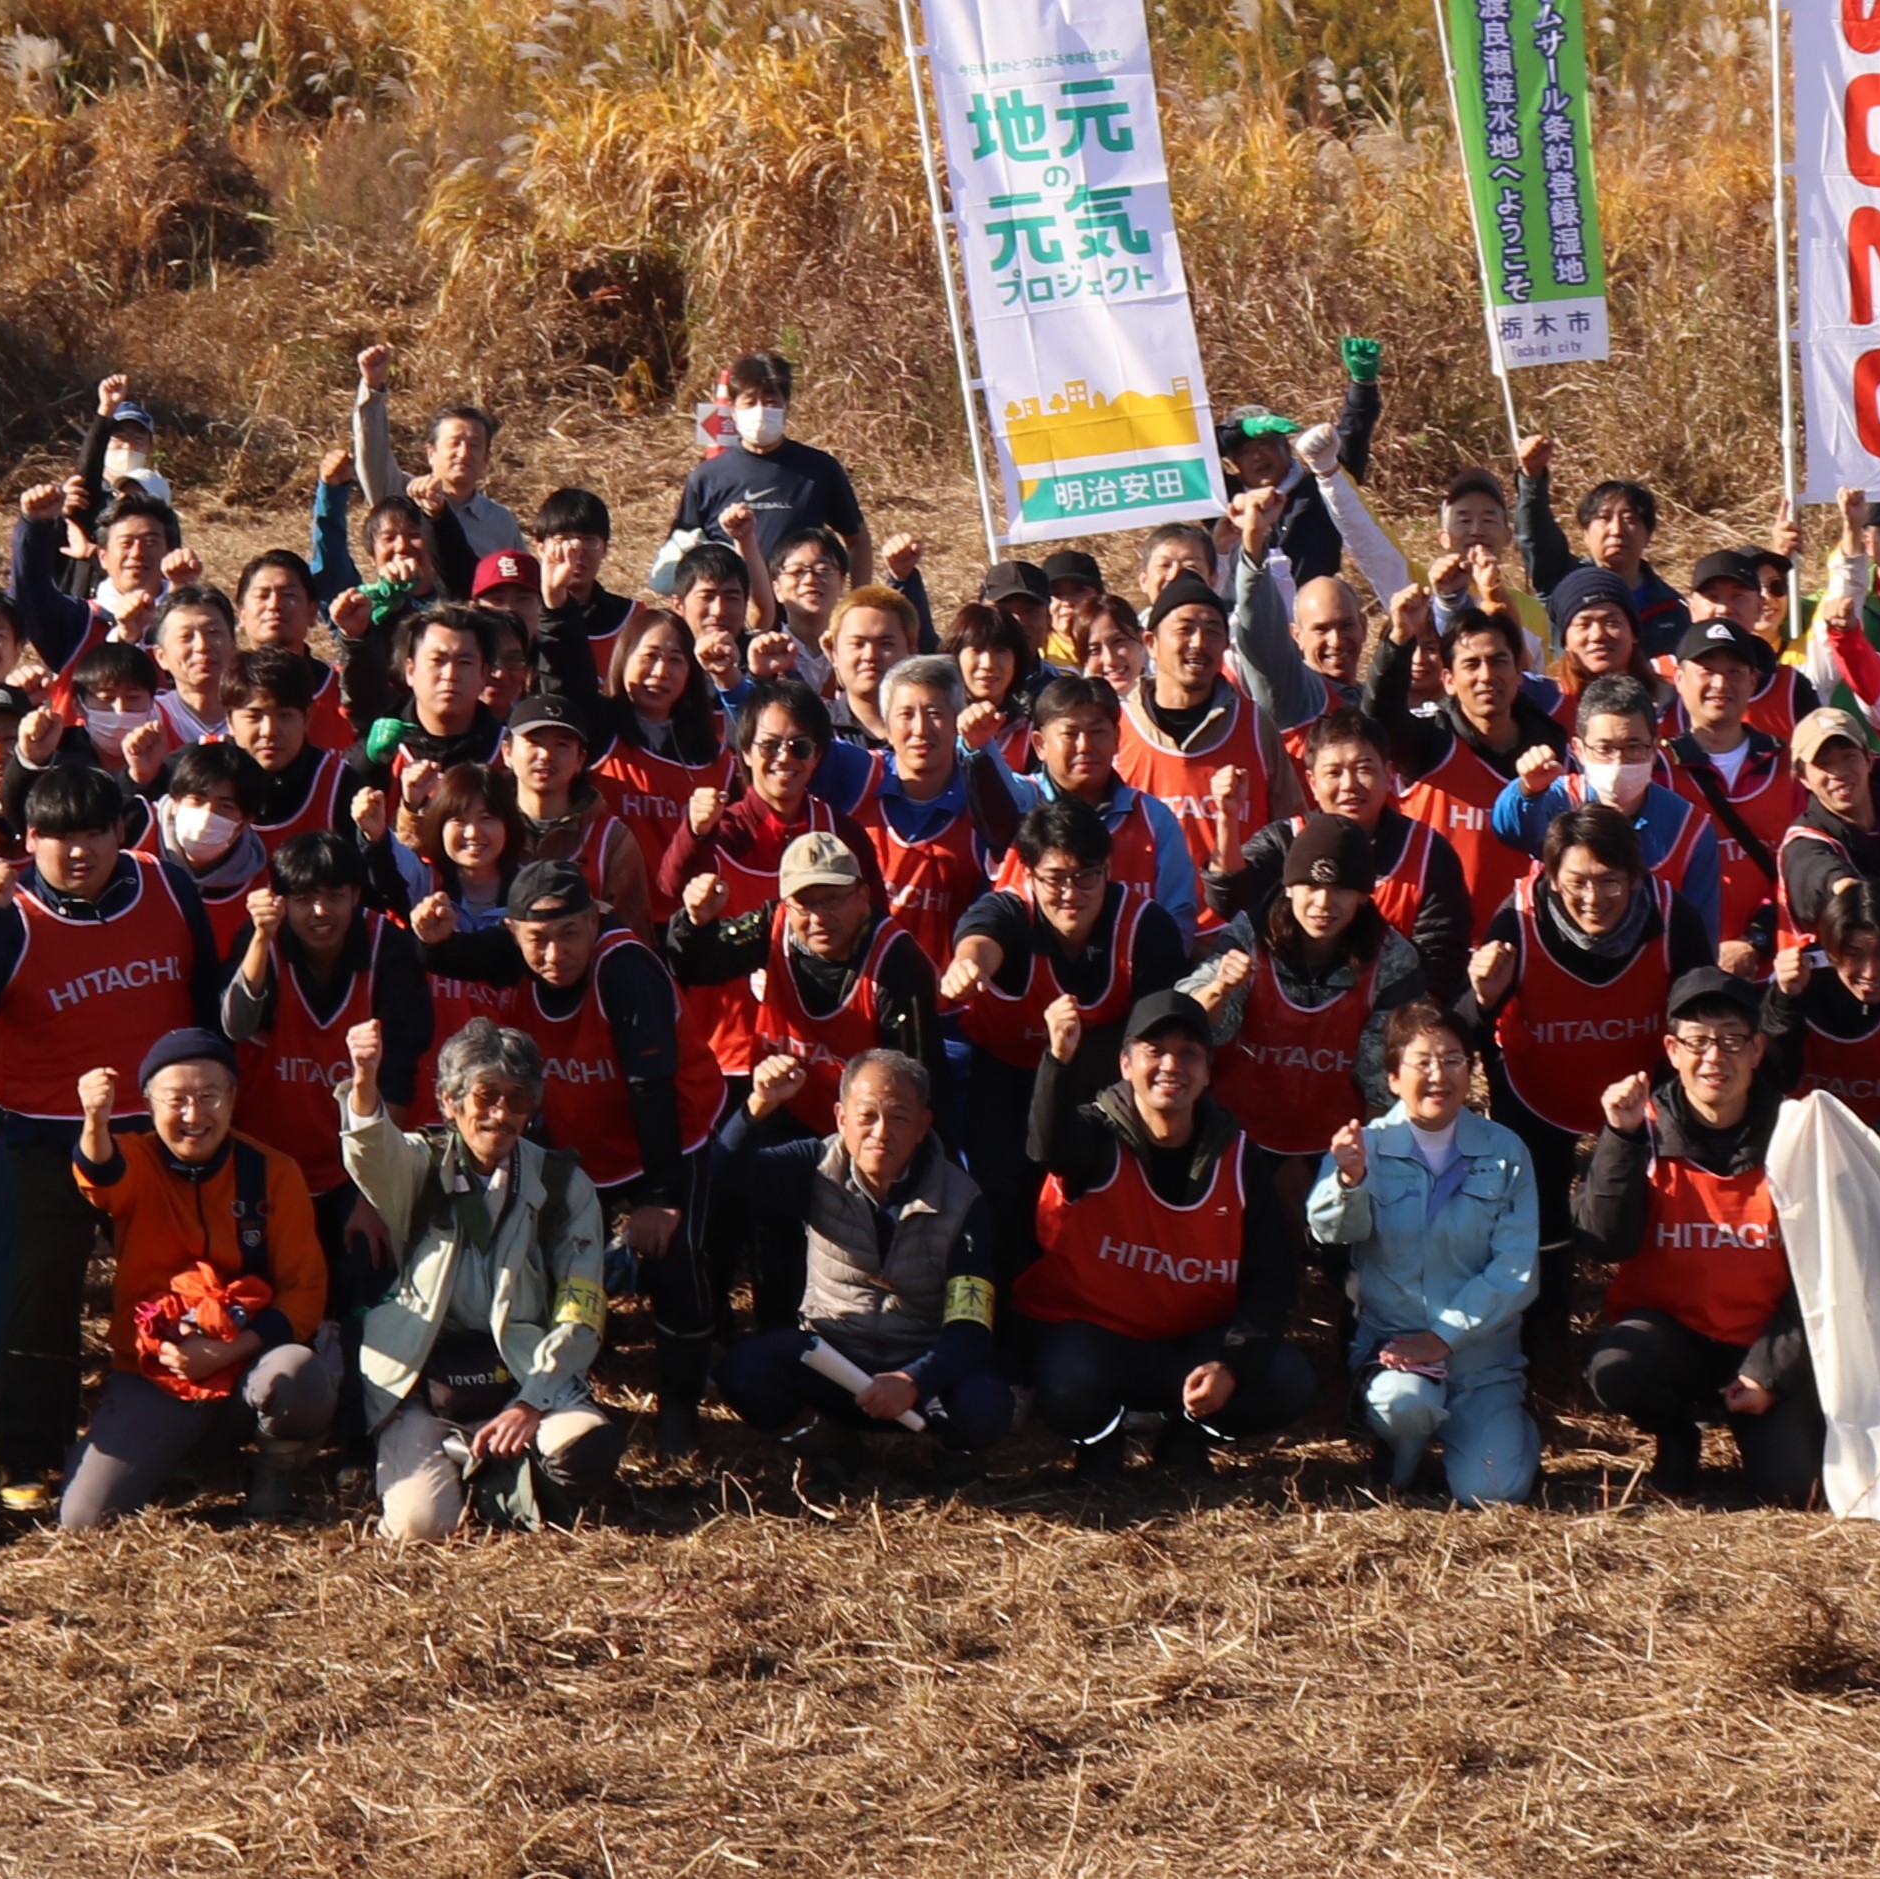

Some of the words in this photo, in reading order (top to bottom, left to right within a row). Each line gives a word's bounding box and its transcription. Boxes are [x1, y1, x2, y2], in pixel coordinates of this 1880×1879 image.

[966, 78, 1135, 162] 地元
[1042, 166, 1071, 187] の
[984, 184, 1152, 272] 元気
[996, 265, 1154, 306] プロジェクト
[1500, 310, 1591, 341] 栃木市
[1558, 340, 1582, 353] city
[1054, 468, 1185, 511] 明治安田
[48, 956, 181, 1011] HITACHI
[541, 1059, 615, 1085] ACHI
[1099, 1236, 1239, 1284] HITACHI
